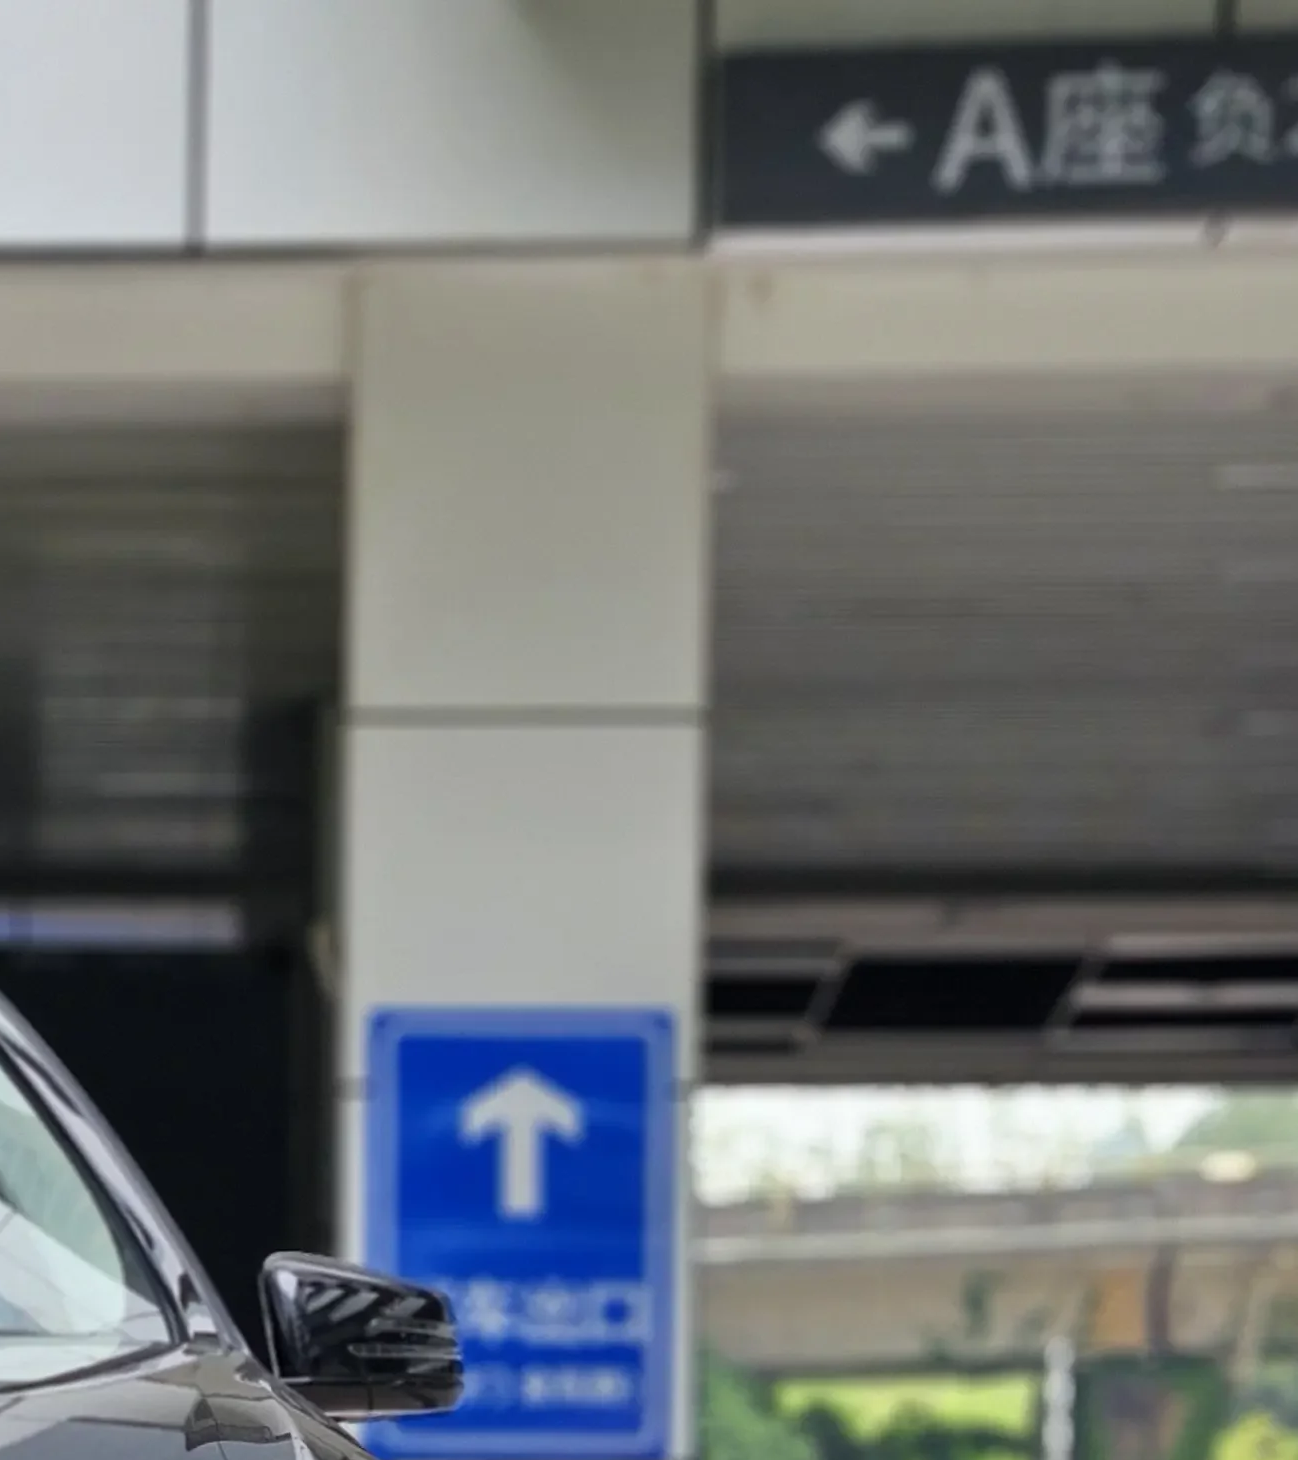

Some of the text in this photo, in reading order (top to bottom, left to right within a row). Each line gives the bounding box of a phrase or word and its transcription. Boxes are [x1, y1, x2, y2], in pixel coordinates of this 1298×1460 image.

[931, 60, 1298, 193] A座 负
[441, 1275, 653, 1344] 车出口
